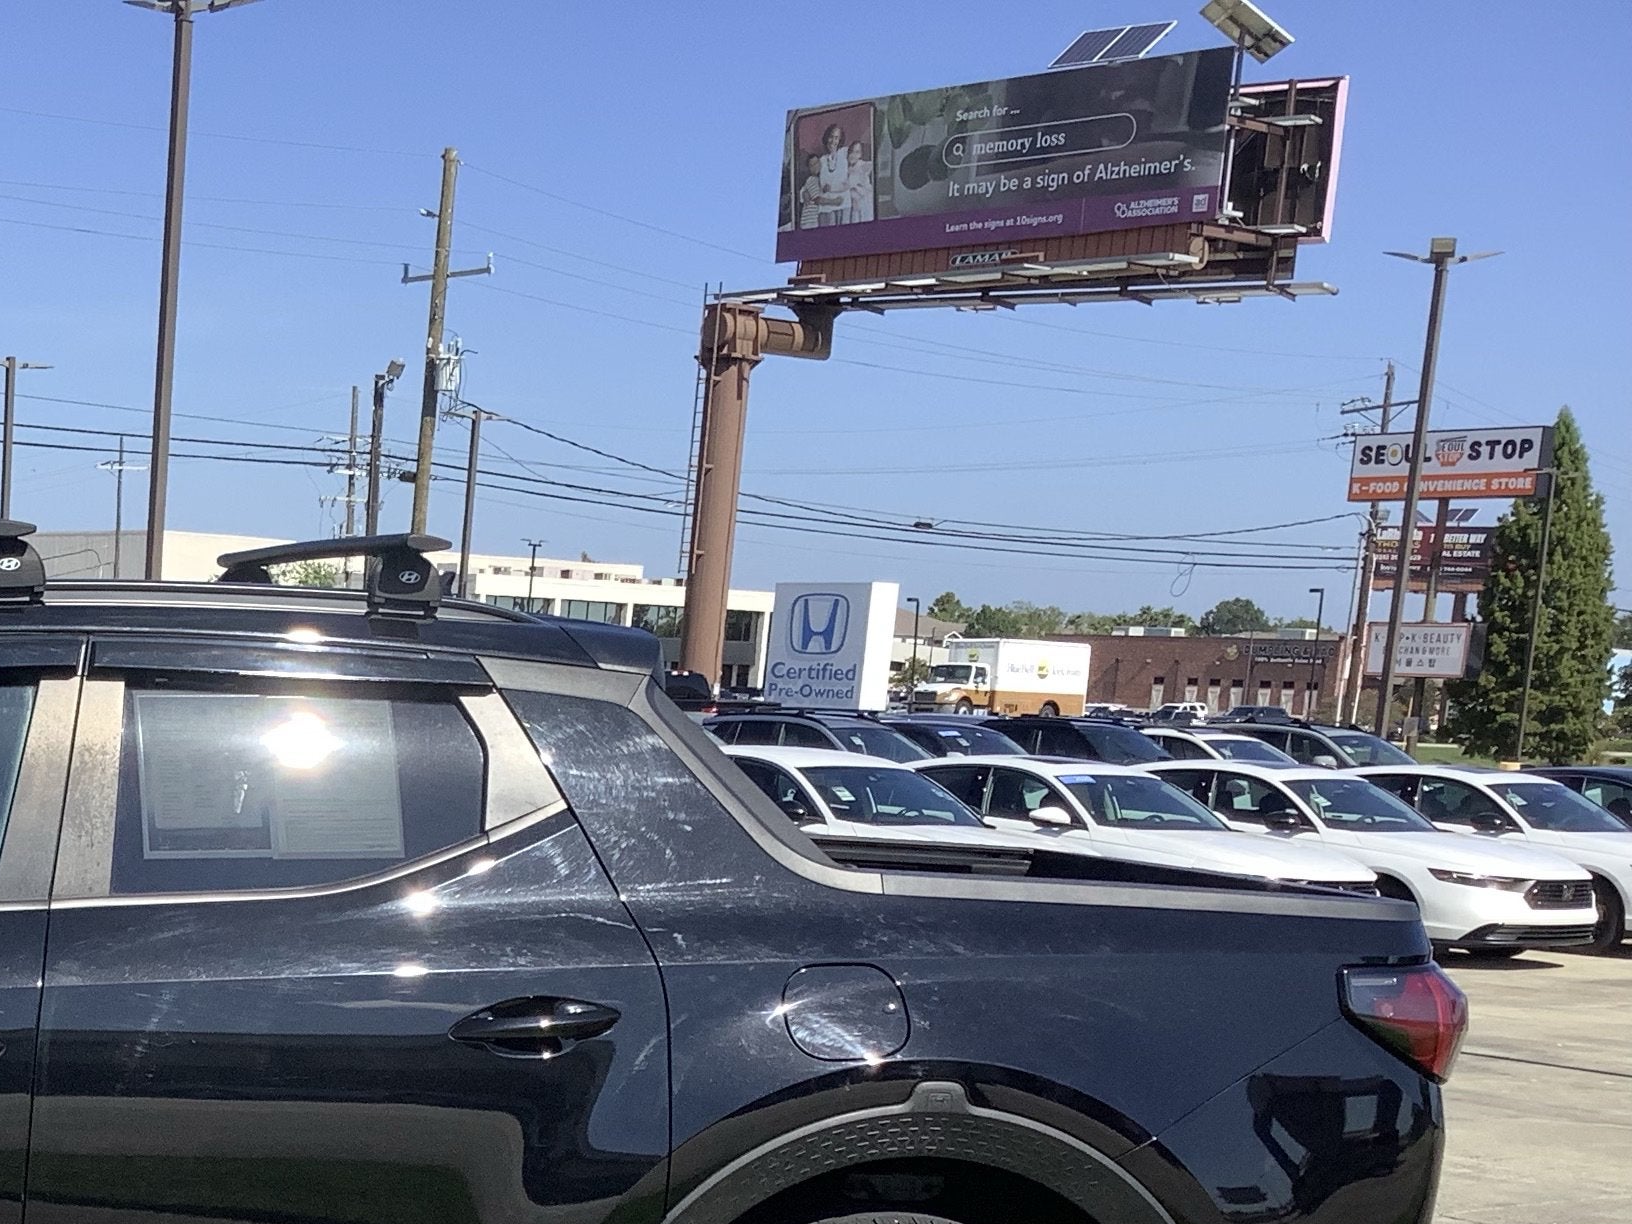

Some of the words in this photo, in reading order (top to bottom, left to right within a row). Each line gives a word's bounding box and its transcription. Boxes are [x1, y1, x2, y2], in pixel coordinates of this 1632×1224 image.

[955, 106, 990, 122] Search
[992, 105, 1009, 118] for
[972, 137, 1033, 156] memory
[1036, 131, 1066, 149] loss
[948, 181, 960, 197] It
[964, 180, 994, 198] may
[999, 174, 1018, 192] be
[1023, 176, 1032, 189] a
[1036, 169, 1068, 191] sign
[1073, 164, 1092, 184] of
[1127, 206, 1179, 218] ASSOCIATION
[945, 221, 968, 233] Learn
[969, 219, 983, 230] the
[984, 217, 1004, 231] signs
[1006, 216, 1015, 227] at
[1016, 213, 1064, 229] 10signs.org
[1467, 438, 1535, 461] STOP
[1351, 481, 1400, 495] K-FOOD
[1490, 477, 1533, 490] STORE
[1453, 550, 1481, 558] ESTATE
[771, 661, 857, 681] Certified
[768, 682, 855, 699] Pre-Owned
